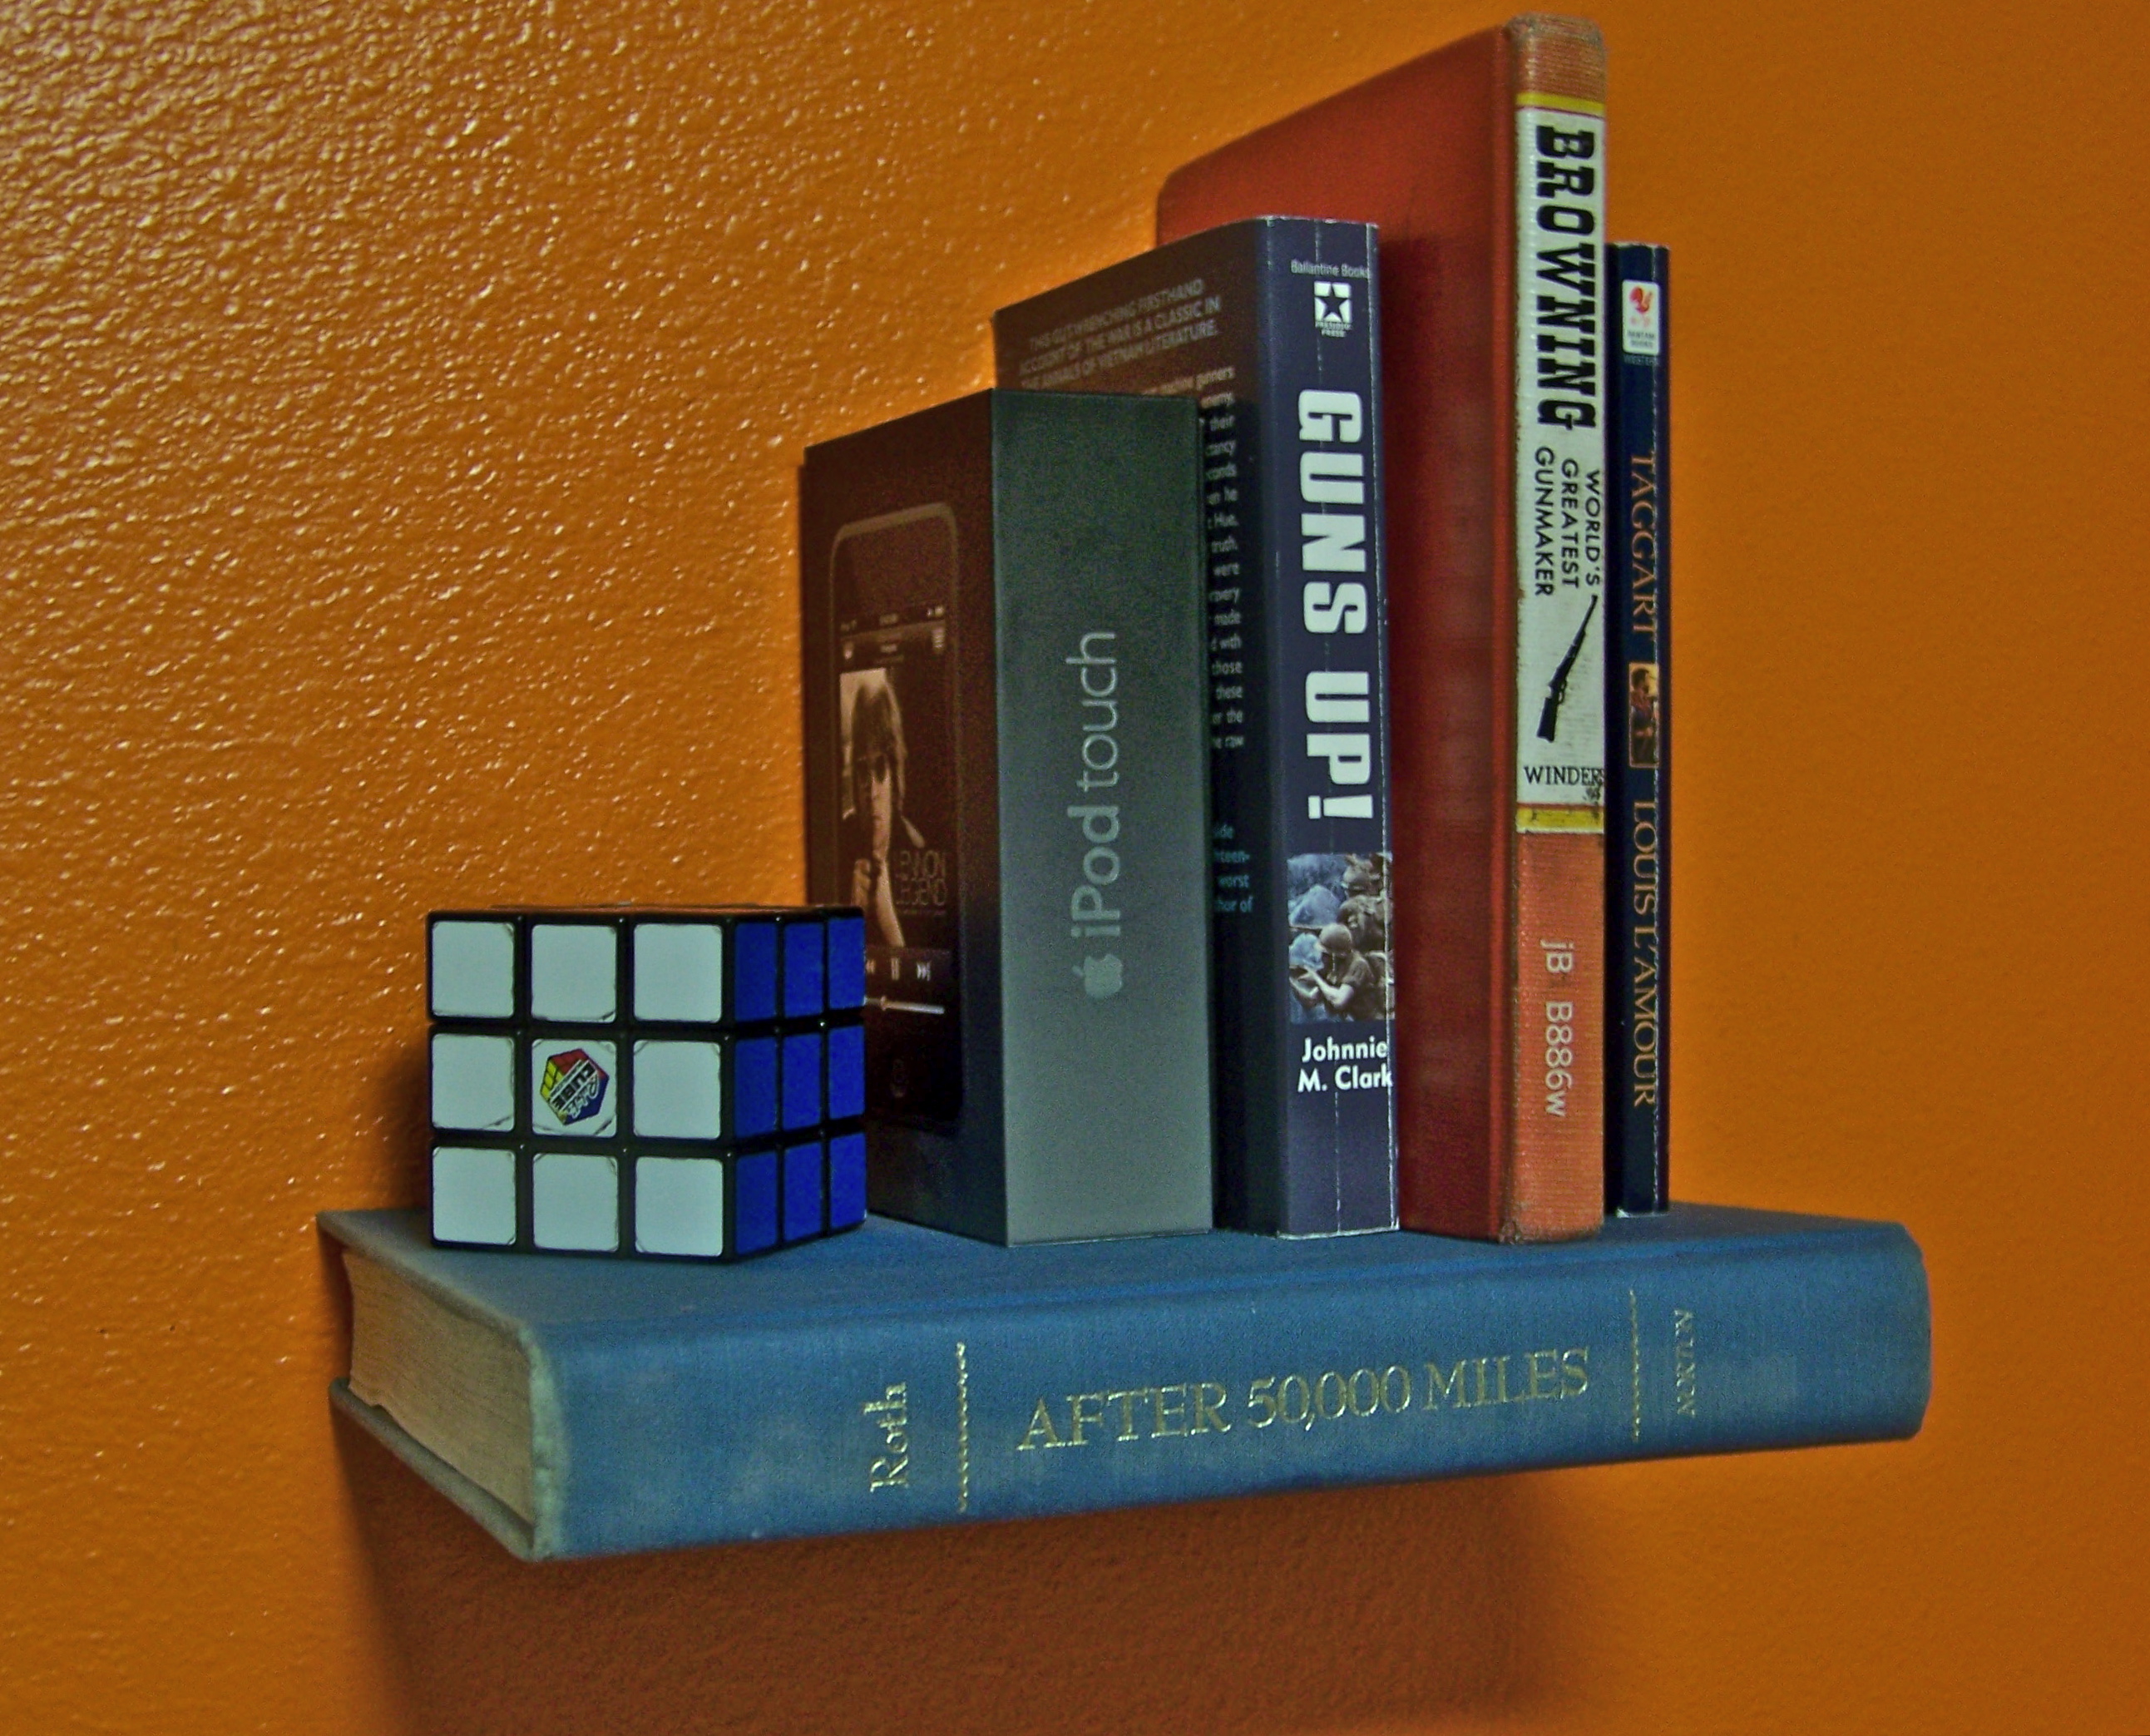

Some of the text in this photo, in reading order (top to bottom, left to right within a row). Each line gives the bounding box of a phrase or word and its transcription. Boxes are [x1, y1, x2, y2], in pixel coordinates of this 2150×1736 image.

[1290, 259, 1370, 279] Ballantine Books
[1535, 125, 1596, 431] BROWNING
[1534, 446, 1555, 596] GUNMAKER
[1560, 457, 1579, 589] GREATEST
[1585, 469, 1601, 586] WORLD'S
[1630, 450, 1657, 637] TAGGART
[1297, 389, 1374, 819] GUNS UP!
[1065, 631, 1121, 937] iPod touch
[1633, 801, 1658, 1108] LOUIS L'AMOUR
[1297, 1062, 1394, 1093] M. Clark
[1302, 1035, 1388, 1063] Johnnie
[1545, 1001, 1574, 1118] B886w
[862, 1381, 910, 1493] Roth
[1016, 1345, 1589, 1452] AFTER 50,000 MILES
